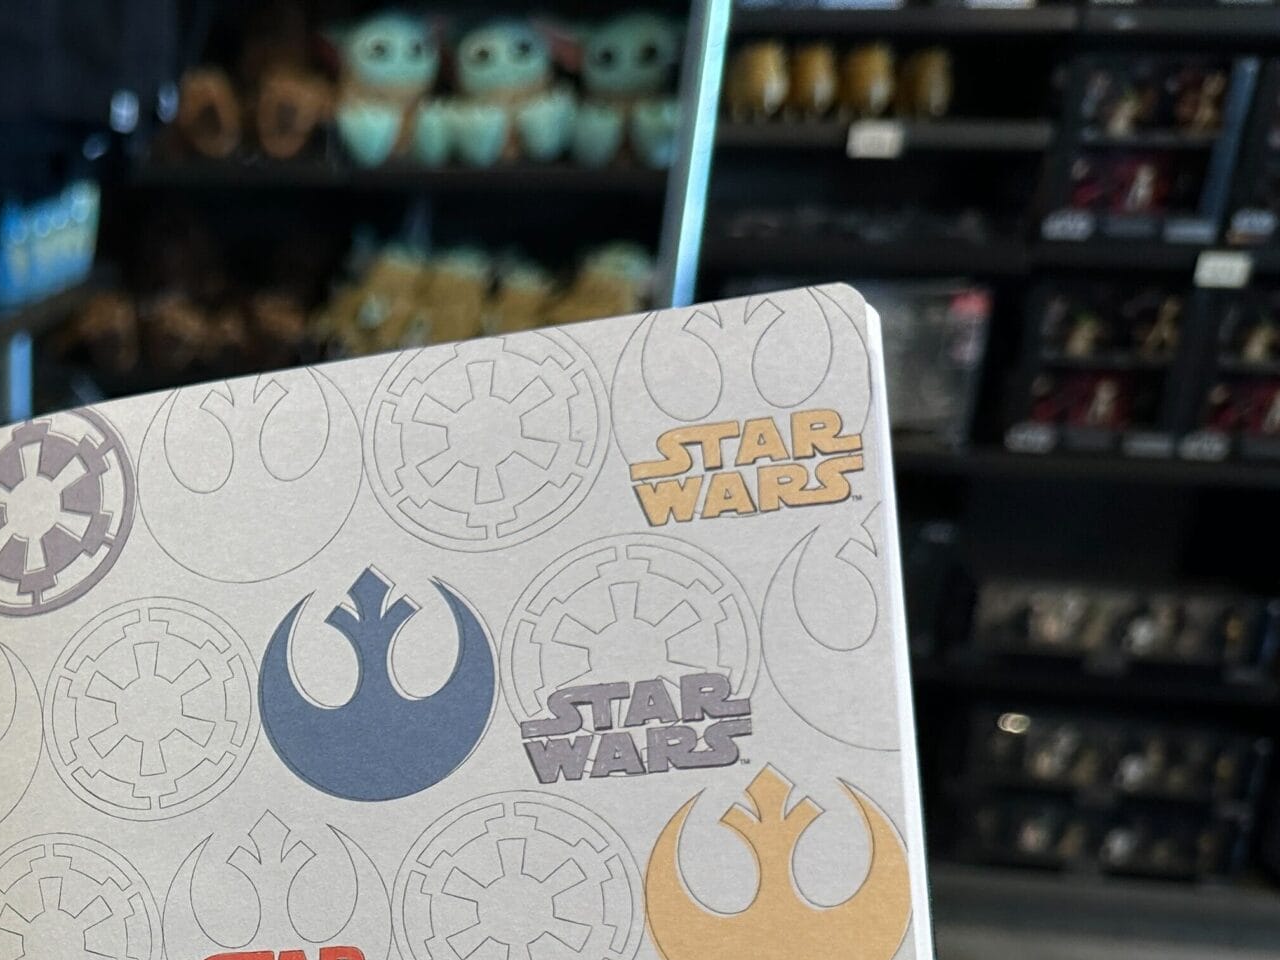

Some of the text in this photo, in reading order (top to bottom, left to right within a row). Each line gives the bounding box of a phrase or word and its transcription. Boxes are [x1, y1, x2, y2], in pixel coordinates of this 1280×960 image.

[629, 408, 863, 481] STAR
[633, 453, 864, 527] WARS
[521, 672, 751, 731] STAR
[523, 718, 753, 784] WARS
